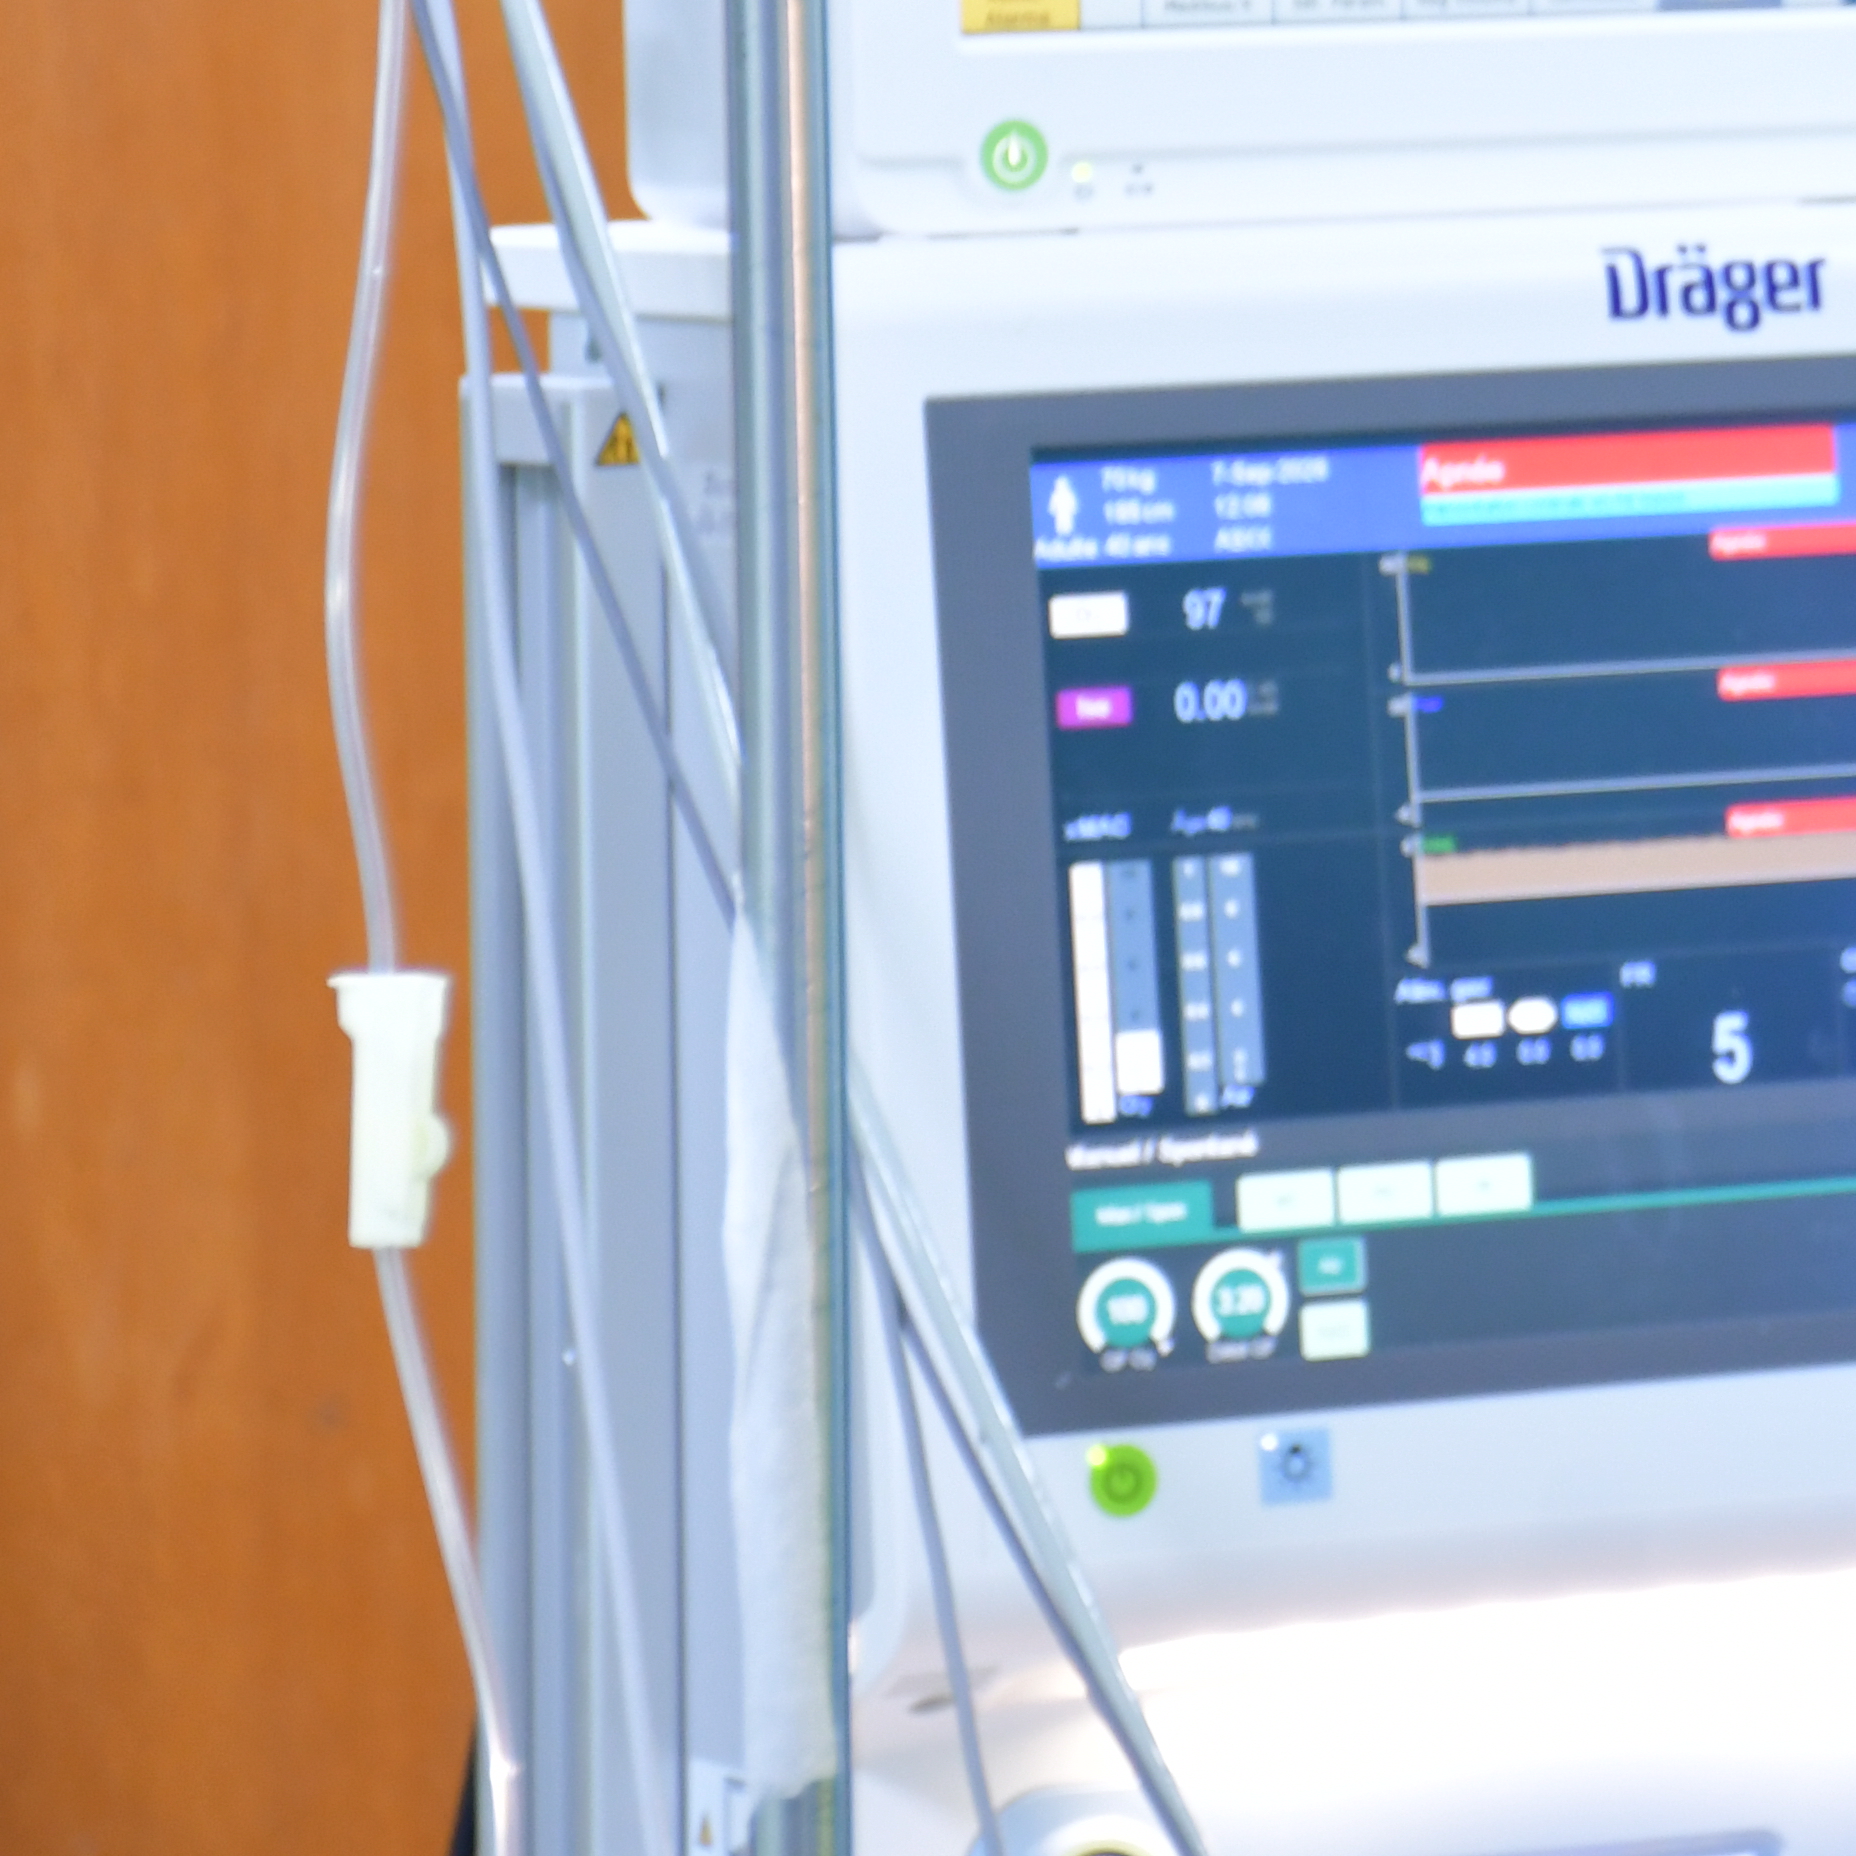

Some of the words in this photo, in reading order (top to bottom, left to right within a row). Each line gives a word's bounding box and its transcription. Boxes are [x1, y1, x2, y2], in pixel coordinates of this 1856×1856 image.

[1600, 244, 1827, 332] Dräger
[1183, 587, 1227, 631] 97
[1173, 679, 1248, 724] 0.00
[1711, 1009, 1755, 1085] 5
